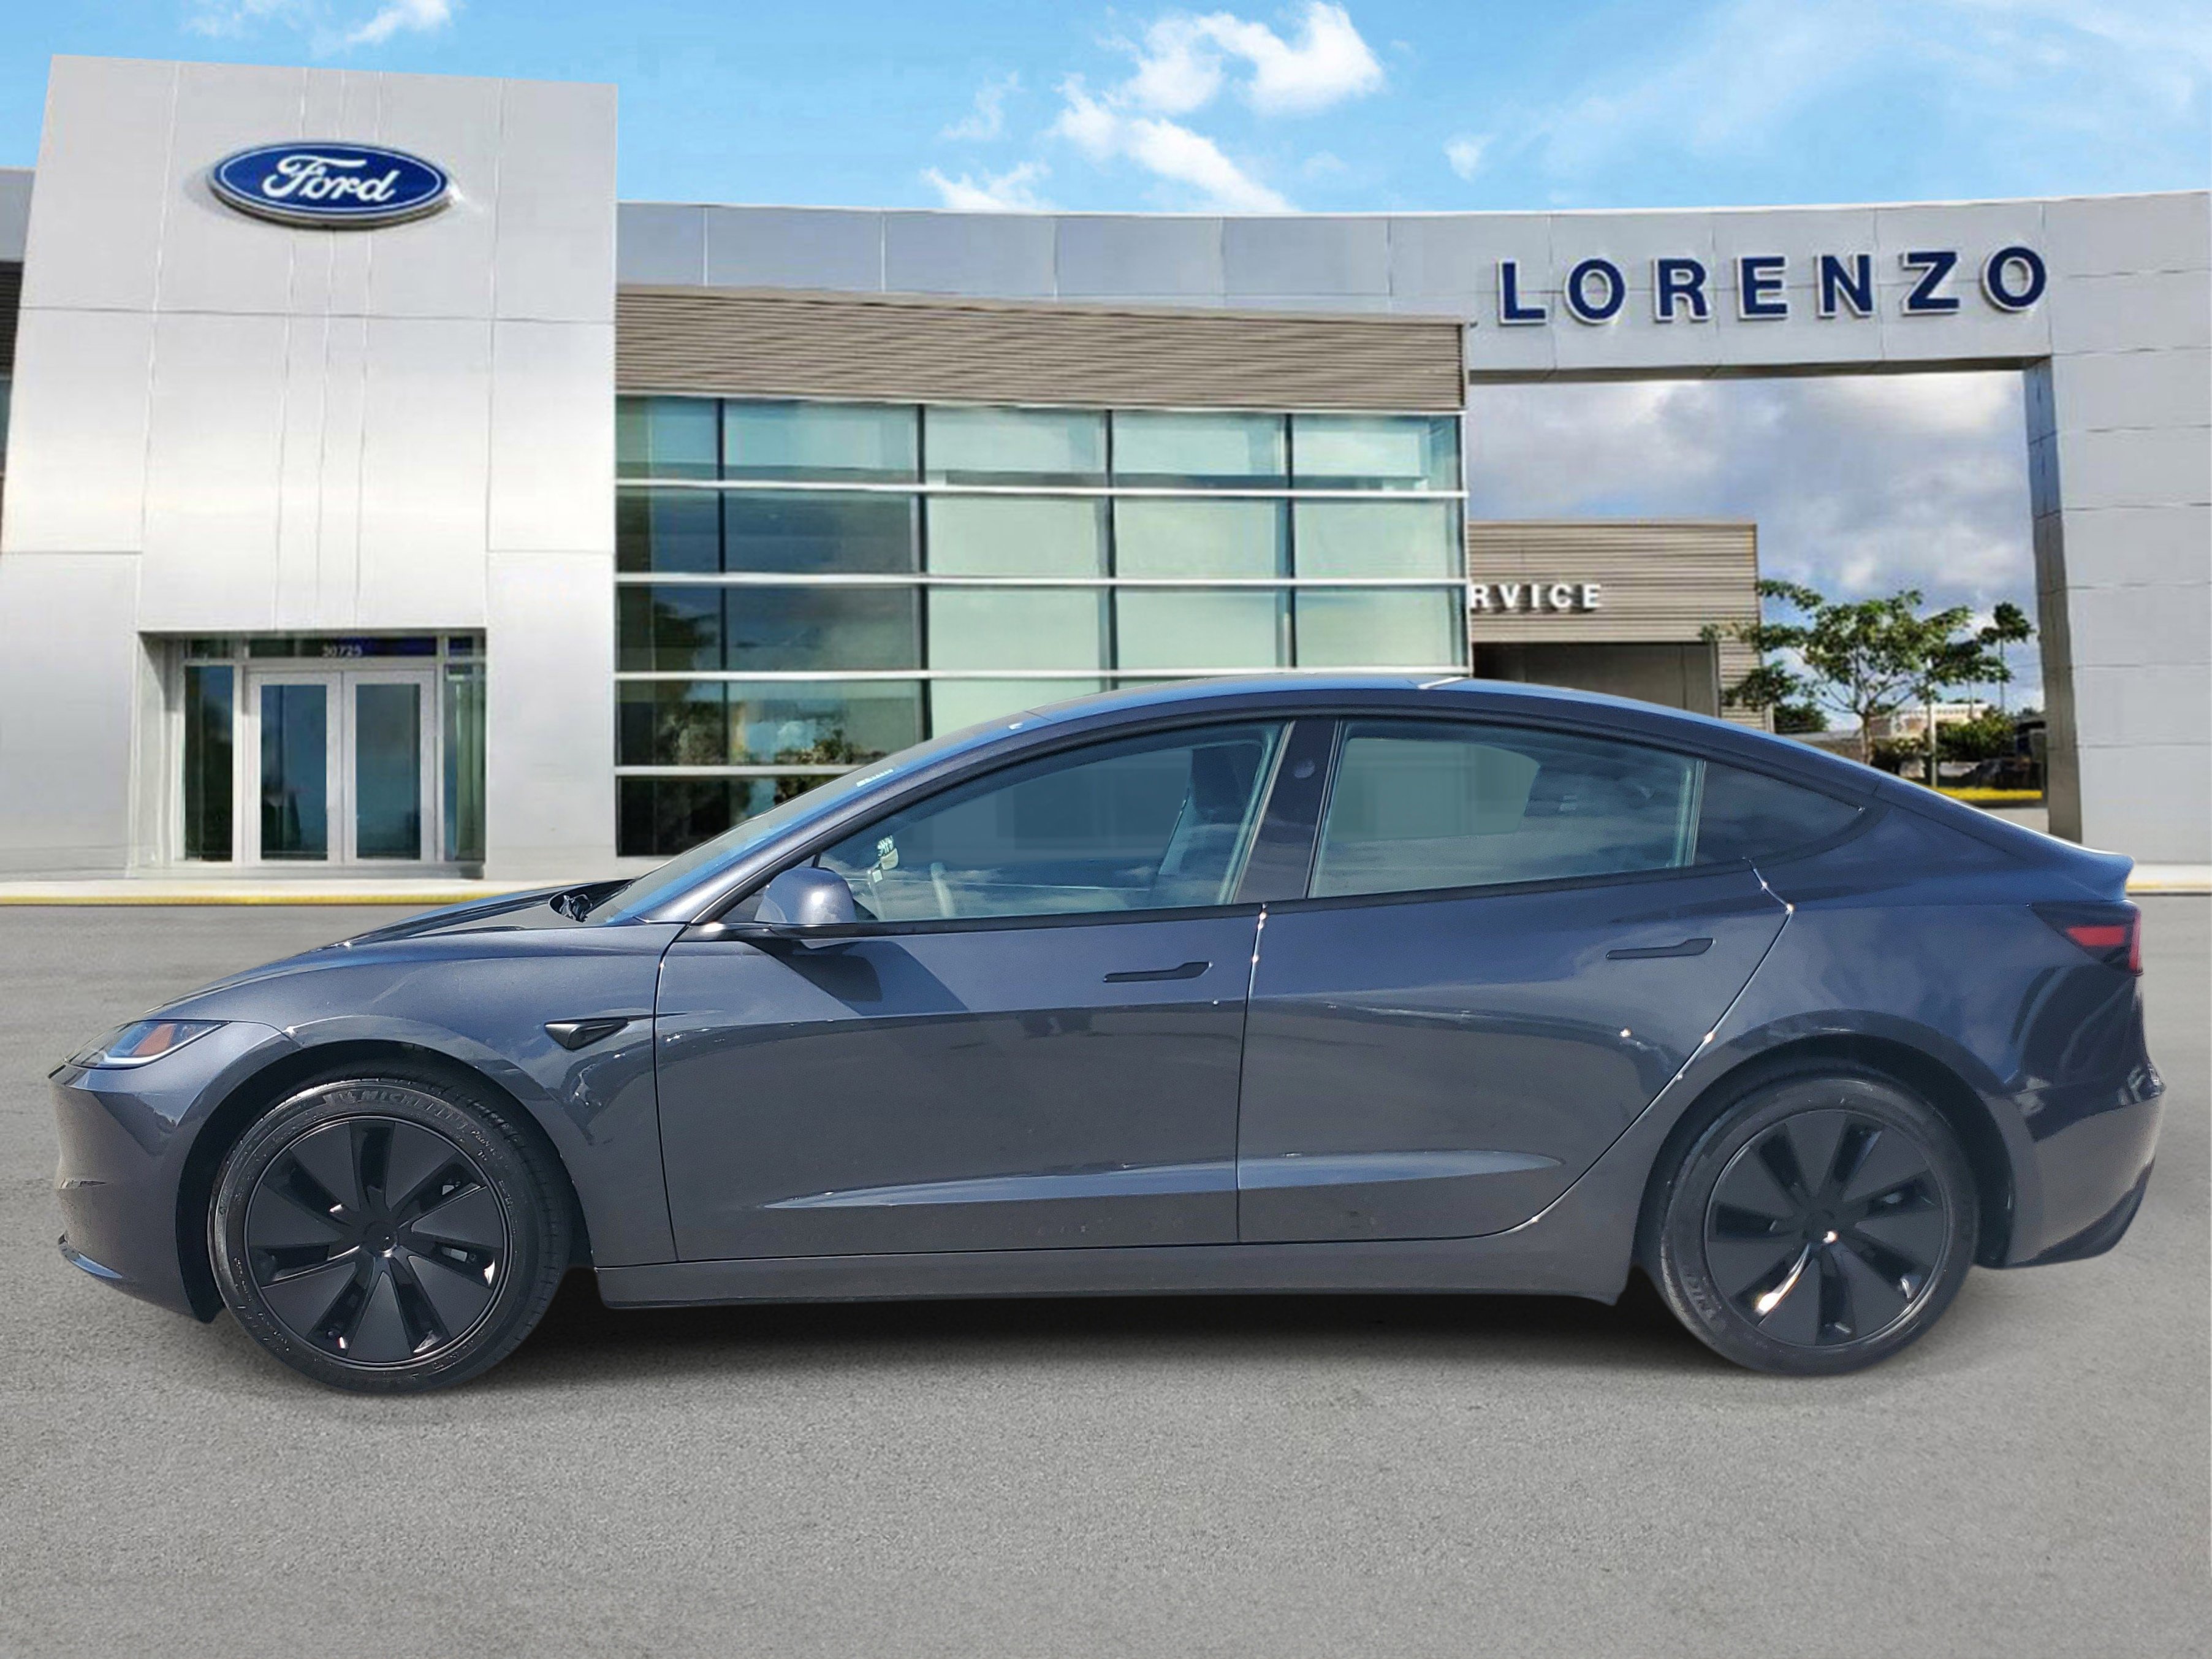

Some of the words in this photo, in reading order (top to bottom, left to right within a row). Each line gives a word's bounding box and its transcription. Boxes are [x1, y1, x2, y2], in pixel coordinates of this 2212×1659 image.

[262, 154, 400, 202] Ford
[1499, 246, 2046, 322] LORENZO
[1470, 584, 1602, 608] RVICE
